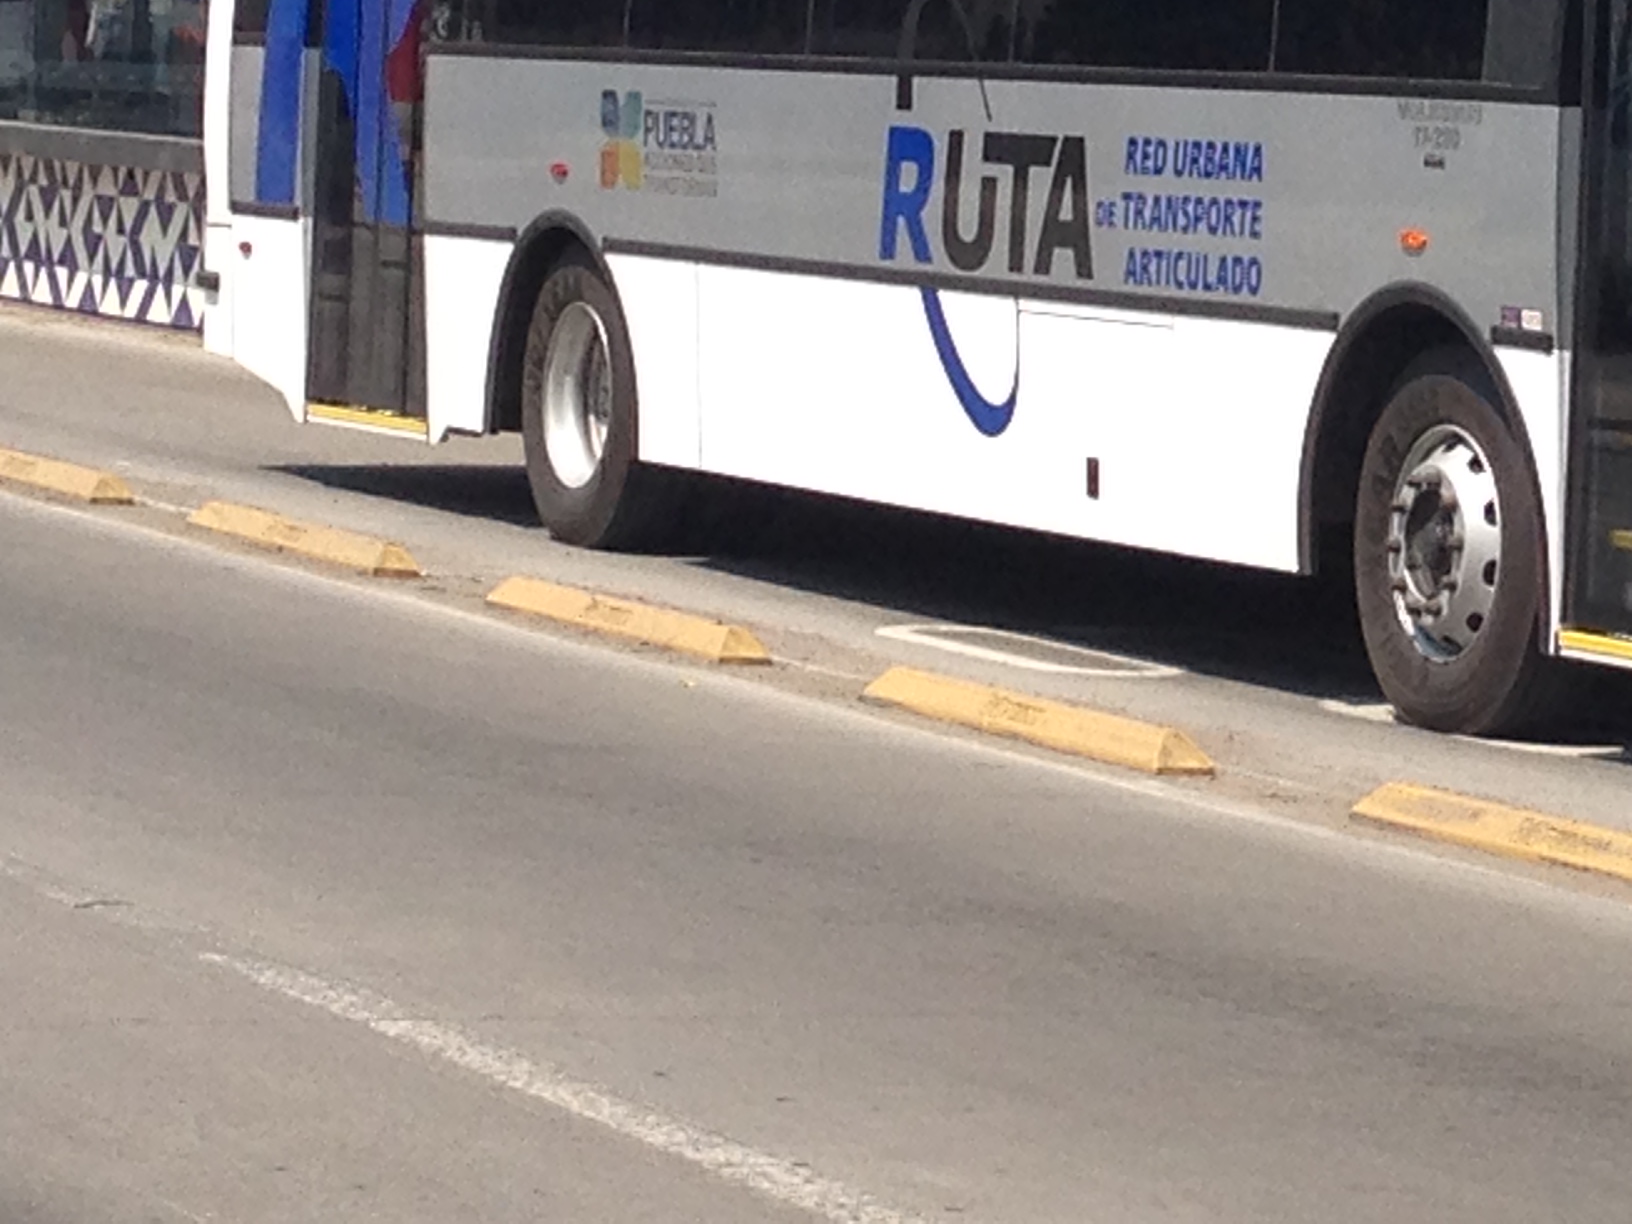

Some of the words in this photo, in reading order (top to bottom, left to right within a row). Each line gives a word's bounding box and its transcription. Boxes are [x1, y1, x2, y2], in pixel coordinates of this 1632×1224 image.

[643, 108, 717, 152] PUEBLA
[1125, 136, 1169, 177] RED
[1173, 139, 1264, 183] URBANA
[878, 125, 1095, 280] RUTA
[1095, 199, 1118, 228] DE
[1121, 192, 1263, 239] TRANSPORTE
[1123, 247, 1263, 297] ARTICULADO
